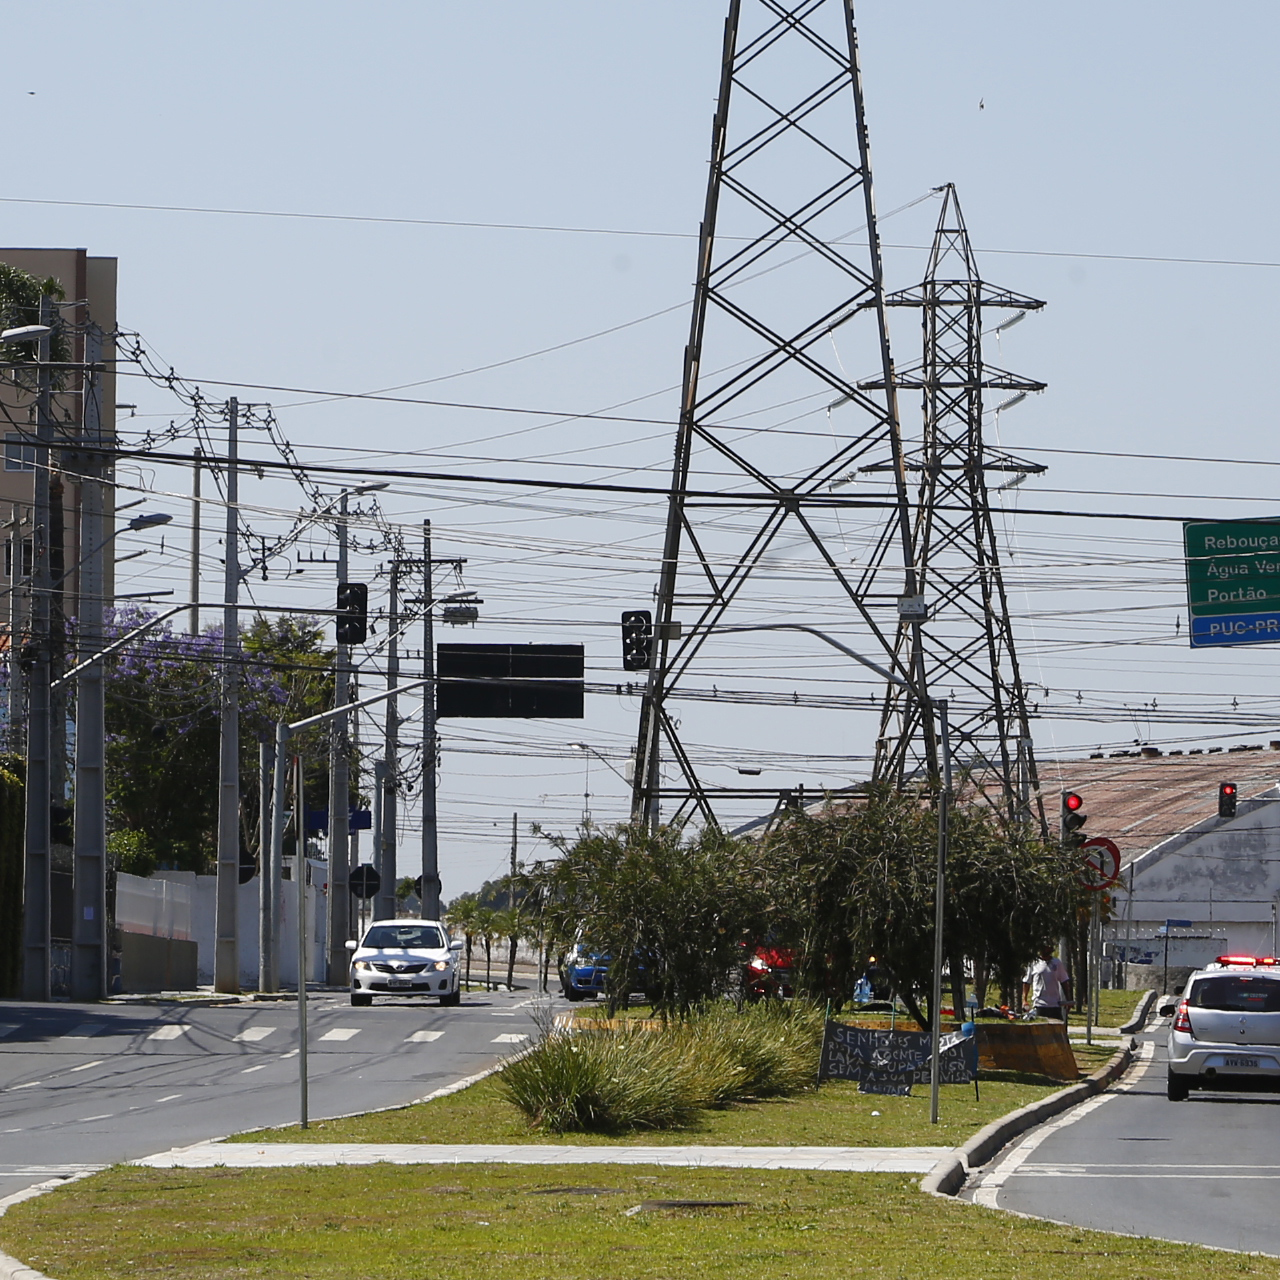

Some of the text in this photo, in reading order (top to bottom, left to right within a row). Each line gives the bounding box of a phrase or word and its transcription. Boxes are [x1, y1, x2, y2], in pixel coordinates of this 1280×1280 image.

[1207, 559, 1249, 578] Água
[1207, 586, 1268, 603] Portão
[1209, 619, 1279, 637] PUC-PR
[828, 1063, 862, 1080] SEM
